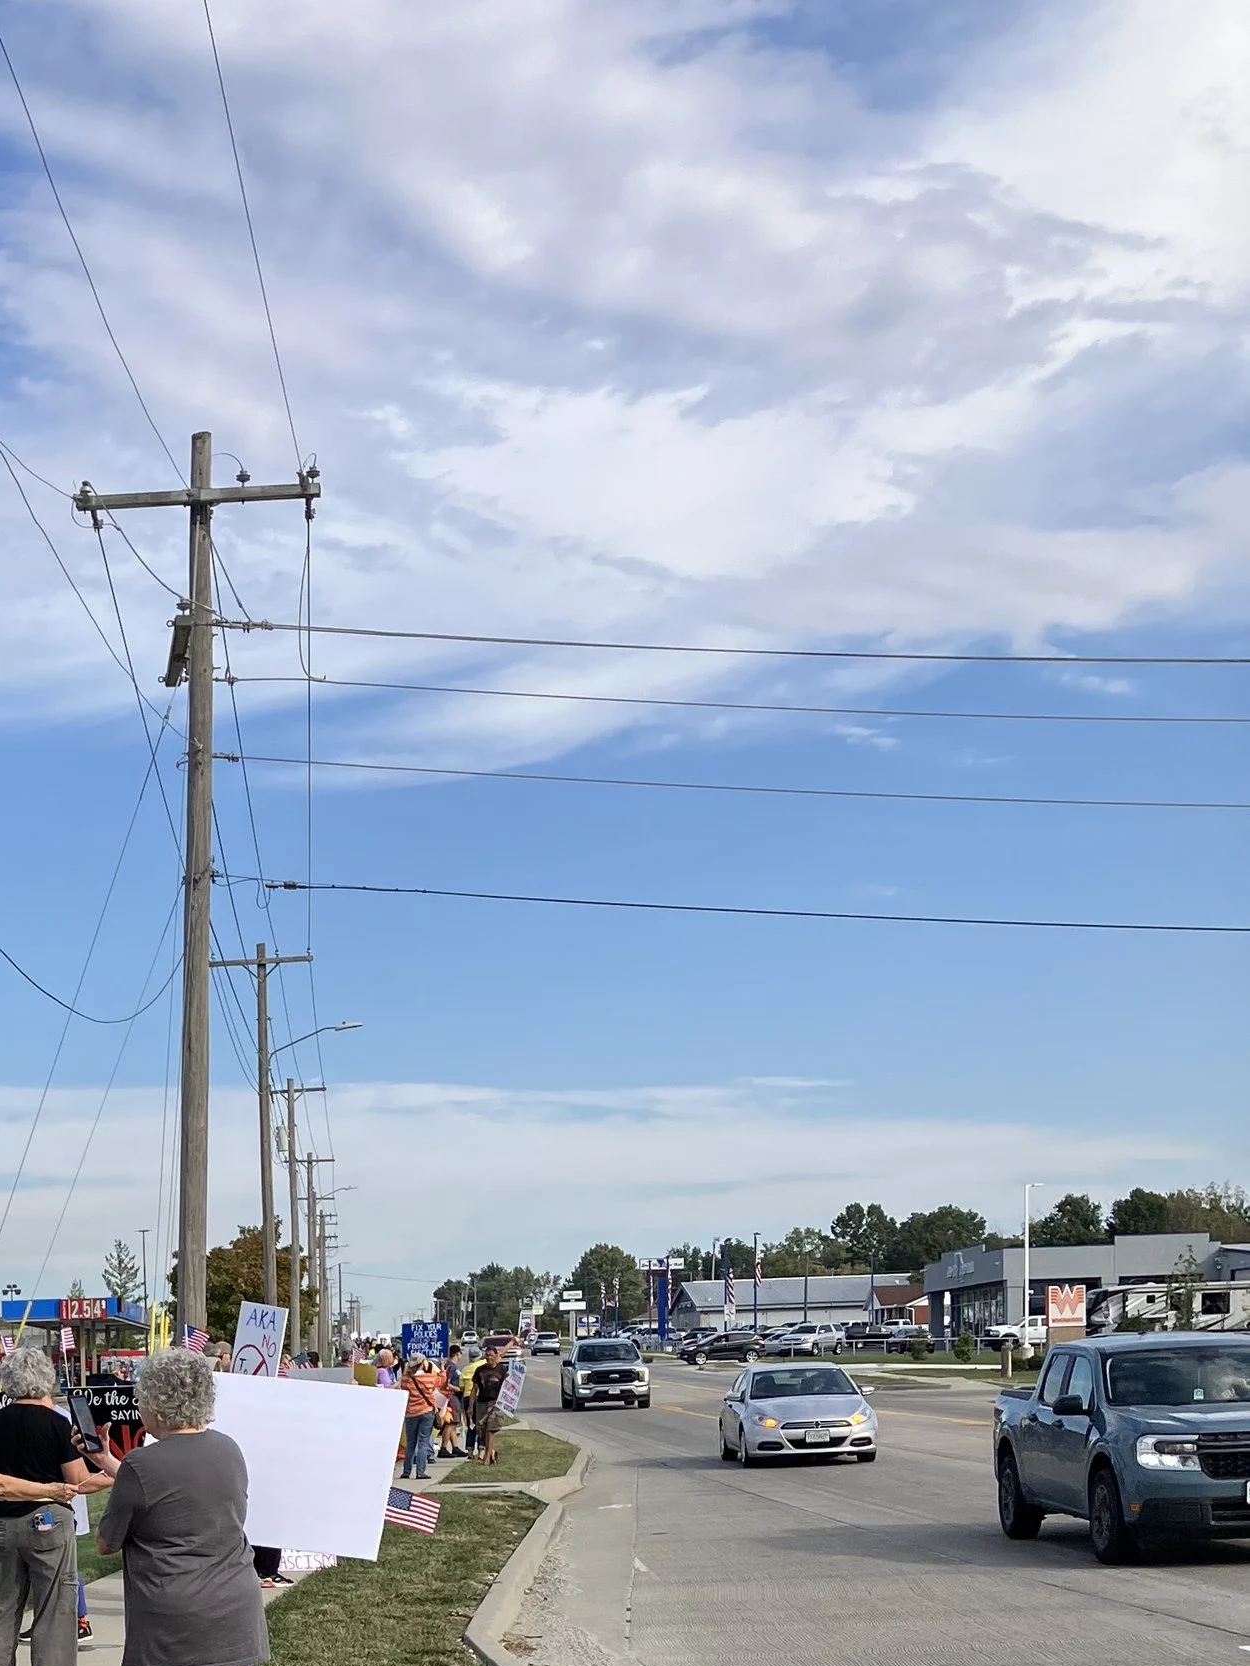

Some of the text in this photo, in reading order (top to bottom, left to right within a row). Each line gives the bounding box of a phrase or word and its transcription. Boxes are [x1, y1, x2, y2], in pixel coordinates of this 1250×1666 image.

[246, 1308, 276, 1331] AKA
[262, 1334, 277, 1358] NO
[430, 1341, 443, 1349] THE
[104, 1390, 129, 1406] the
